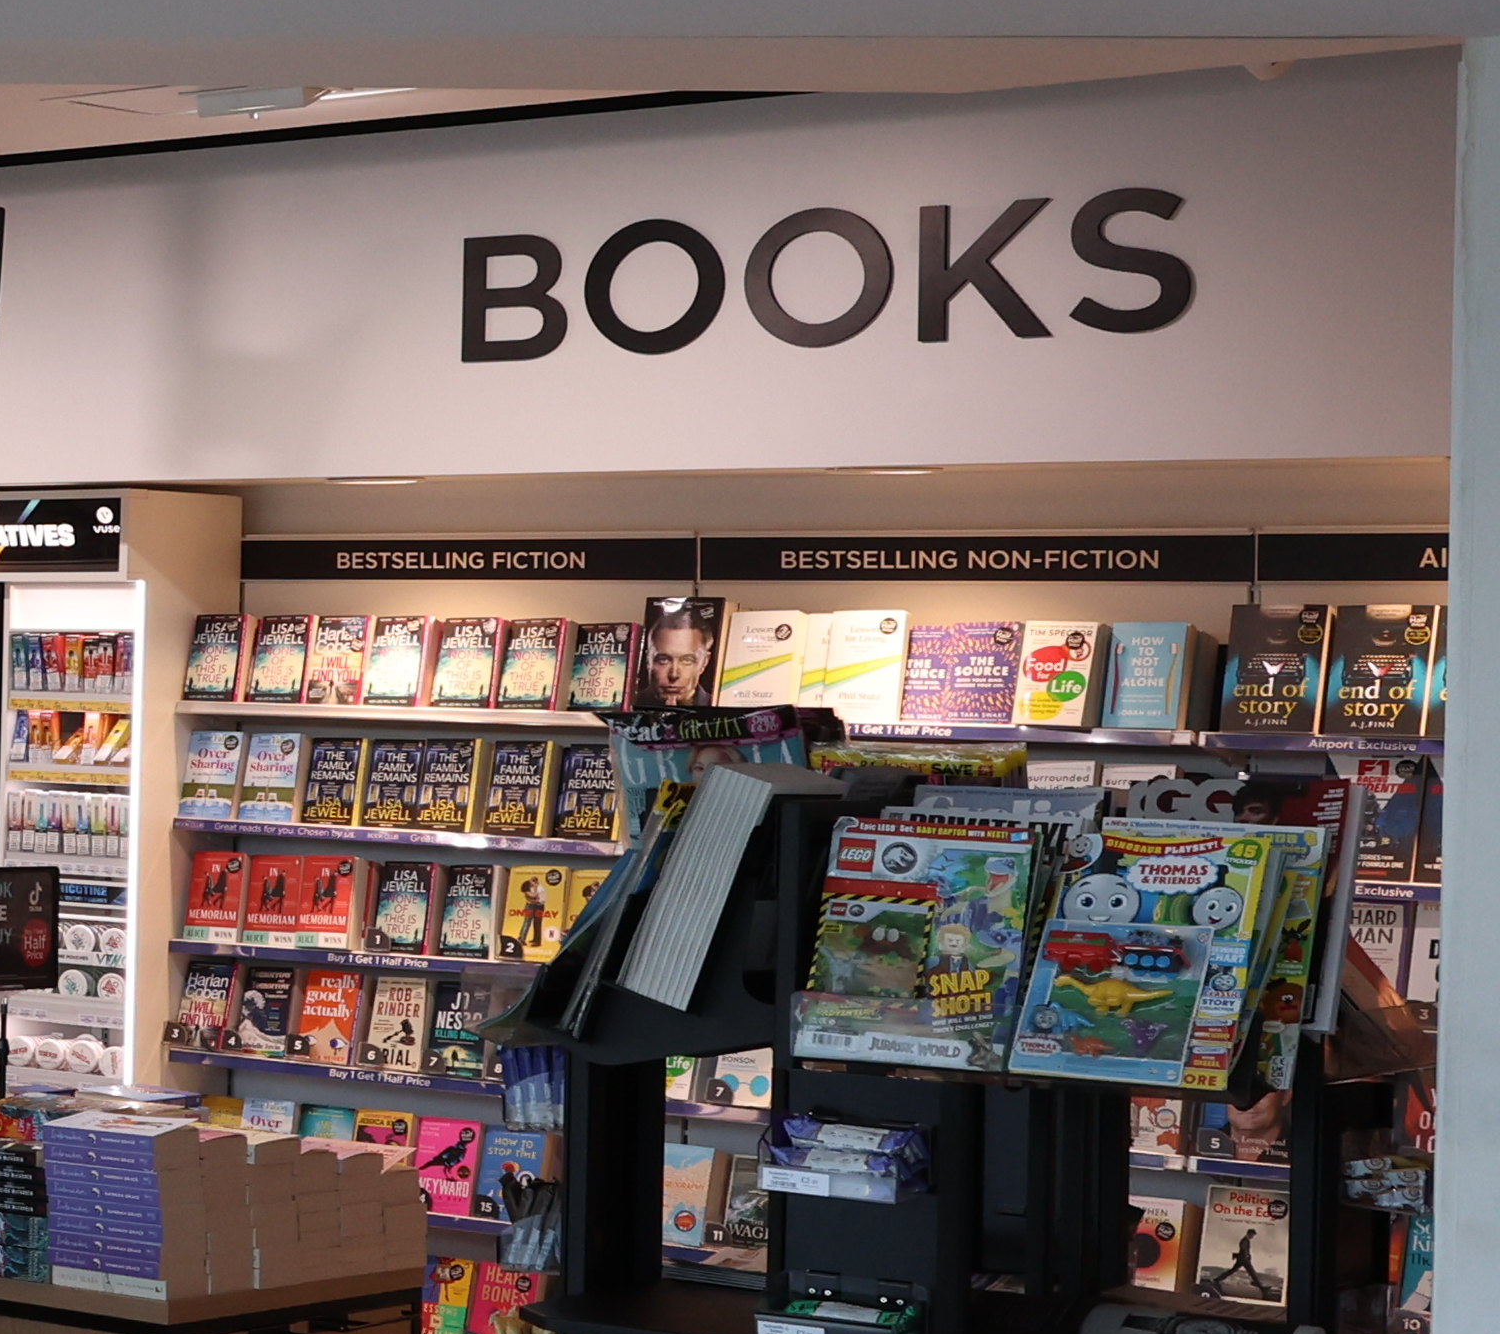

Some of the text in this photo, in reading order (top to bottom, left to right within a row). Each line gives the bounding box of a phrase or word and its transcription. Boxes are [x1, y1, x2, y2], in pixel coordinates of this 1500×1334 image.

[460, 185, 1196, 363] BOOKS
[92, 524, 121, 535] vuse
[336, 551, 586, 570] BESTSELLING FICTION
[779, 549, 1160, 572] BESTSELLING NON-FICTION
[587, 632, 615, 643] LISA
[1131, 636, 1164, 647] HOW
[575, 643, 625, 655] JEWELL
[580, 657, 616, 666] NONE
[1025, 657, 1065, 673] Food
[588, 667, 604, 677] OF
[954, 665, 1009, 677] SOURCE
[577, 677, 615, 687] THIS IS
[1050, 679, 1083, 696] Life
[580, 687, 610, 697] TRUE
[1232, 680, 1308, 698] end of
[1238, 699, 1298, 719] story
[1308, 738, 1417, 753] Airport Exclusive
[198, 747, 229, 759] Over
[326, 751, 345, 761] THE
[190, 759, 234, 772] Sharing
[317, 761, 352, 771] FAMILY
[931, 763, 974, 776] SAVE
[311, 770, 355, 780] REMAINS
[1028, 773, 1091, 784] surrounded
[214, 822, 237, 831] Great
[239, 824, 262, 833] reads
[264, 825, 276, 834] for
[298, 827, 329, 837] Chosen
[332, 829, 343, 839] by
[860, 822, 876, 832] Epic
[877, 824, 896, 832] LEGO
[916, 826, 936, 834] BABY
[938, 827, 967, 836] RAPTOR
[968, 829, 986, 837] WITH
[1105, 838, 1219, 855] DINOSAUR PLAYSET!
[1230, 843, 1258, 859] 45
[839, 846, 872, 861] LEGO
[211, 864, 221, 873] IN
[1138, 864, 1209, 877] THOMAS
[1141, 875, 1201, 886] & FRIENDS
[189, 909, 237, 921] MEMORIAM
[186, 928, 233, 939] ALICE WINN
[375, 935, 380, 944] 1
[24, 936, 47, 949] Half
[505, 942, 514, 953] 2
[26, 952, 43, 960] Price
[327, 953, 429, 968] Buy 1 Get 1 Half Price
[188, 972, 229, 988] Harlan
[320, 975, 355, 992] really
[929, 969, 990, 996] SNAP
[185, 987, 226, 1001] Coben
[305, 989, 345, 1004] good,
[388, 987, 412, 1001] ROB
[931, 993, 992, 1018] SHOT!
[1202, 997, 1236, 1008] STORY
[303, 1003, 352, 1021] actually
[377, 1002, 420, 1017] RINDER
[868, 1036, 960, 1058] JURASSIC WORLD
[493, 1136, 534, 1149] HOW TO
[1210, 1138, 1221, 1149] 5
[487, 1147, 538, 1159] STOP TIME
[481, 1201, 492, 1213] 15
[1213, 1203, 1252, 1216] On the
[481, 1285, 530, 1306] BONES
